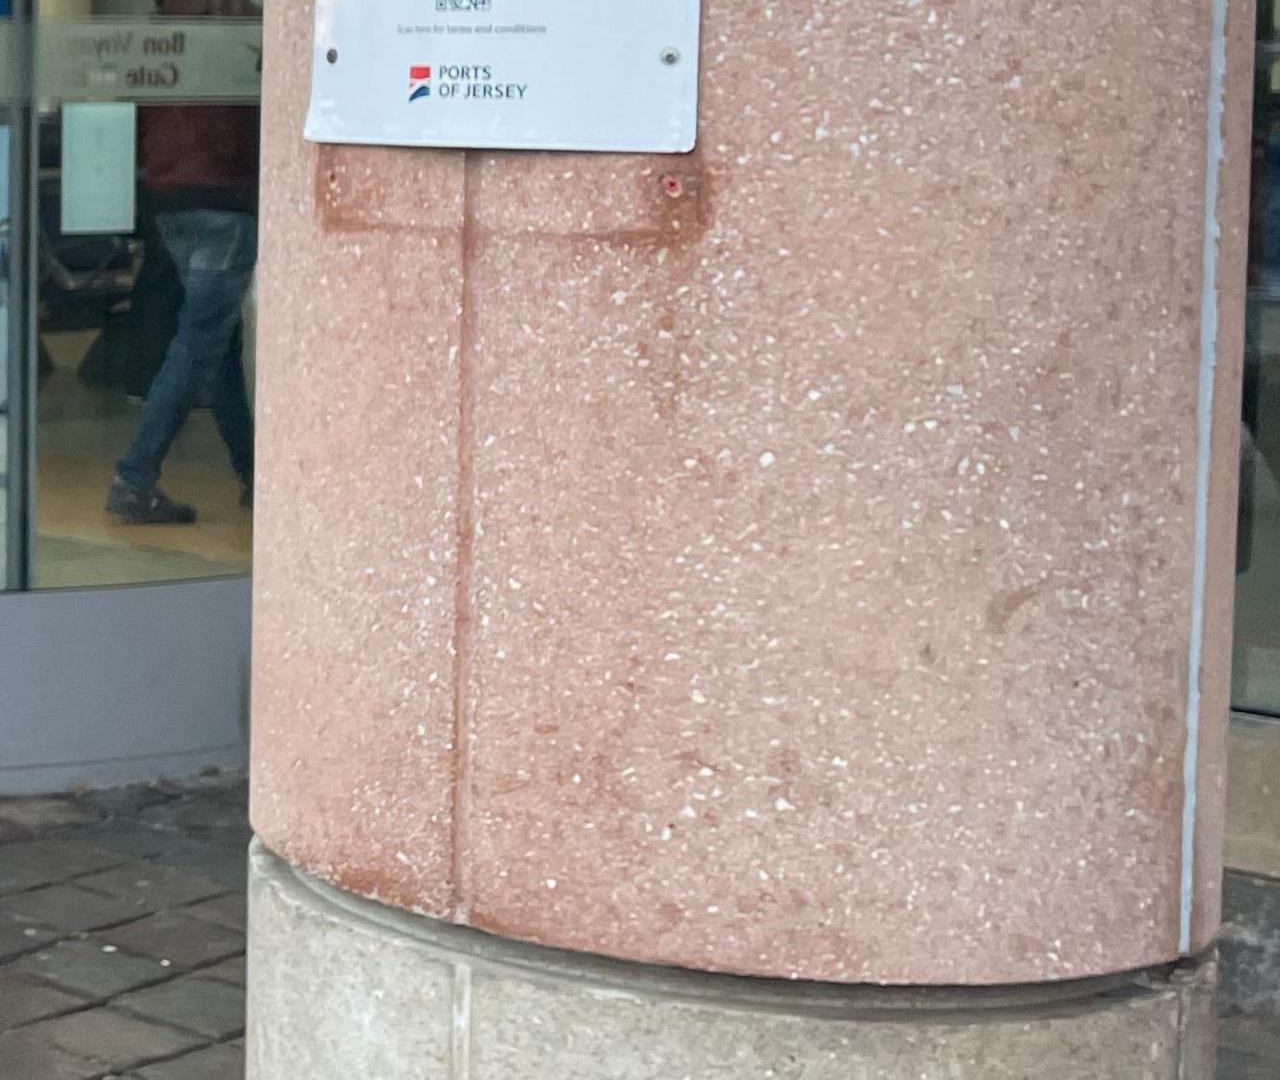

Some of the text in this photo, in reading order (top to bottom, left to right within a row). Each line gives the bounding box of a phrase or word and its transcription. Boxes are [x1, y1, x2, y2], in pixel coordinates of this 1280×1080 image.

[447, 24, 473, 35] terms
[474, 24, 493, 35] and
[494, 24, 547, 35] conditions
[438, 65, 492, 80] PORTS
[439, 83, 528, 100] OF JERSEY
